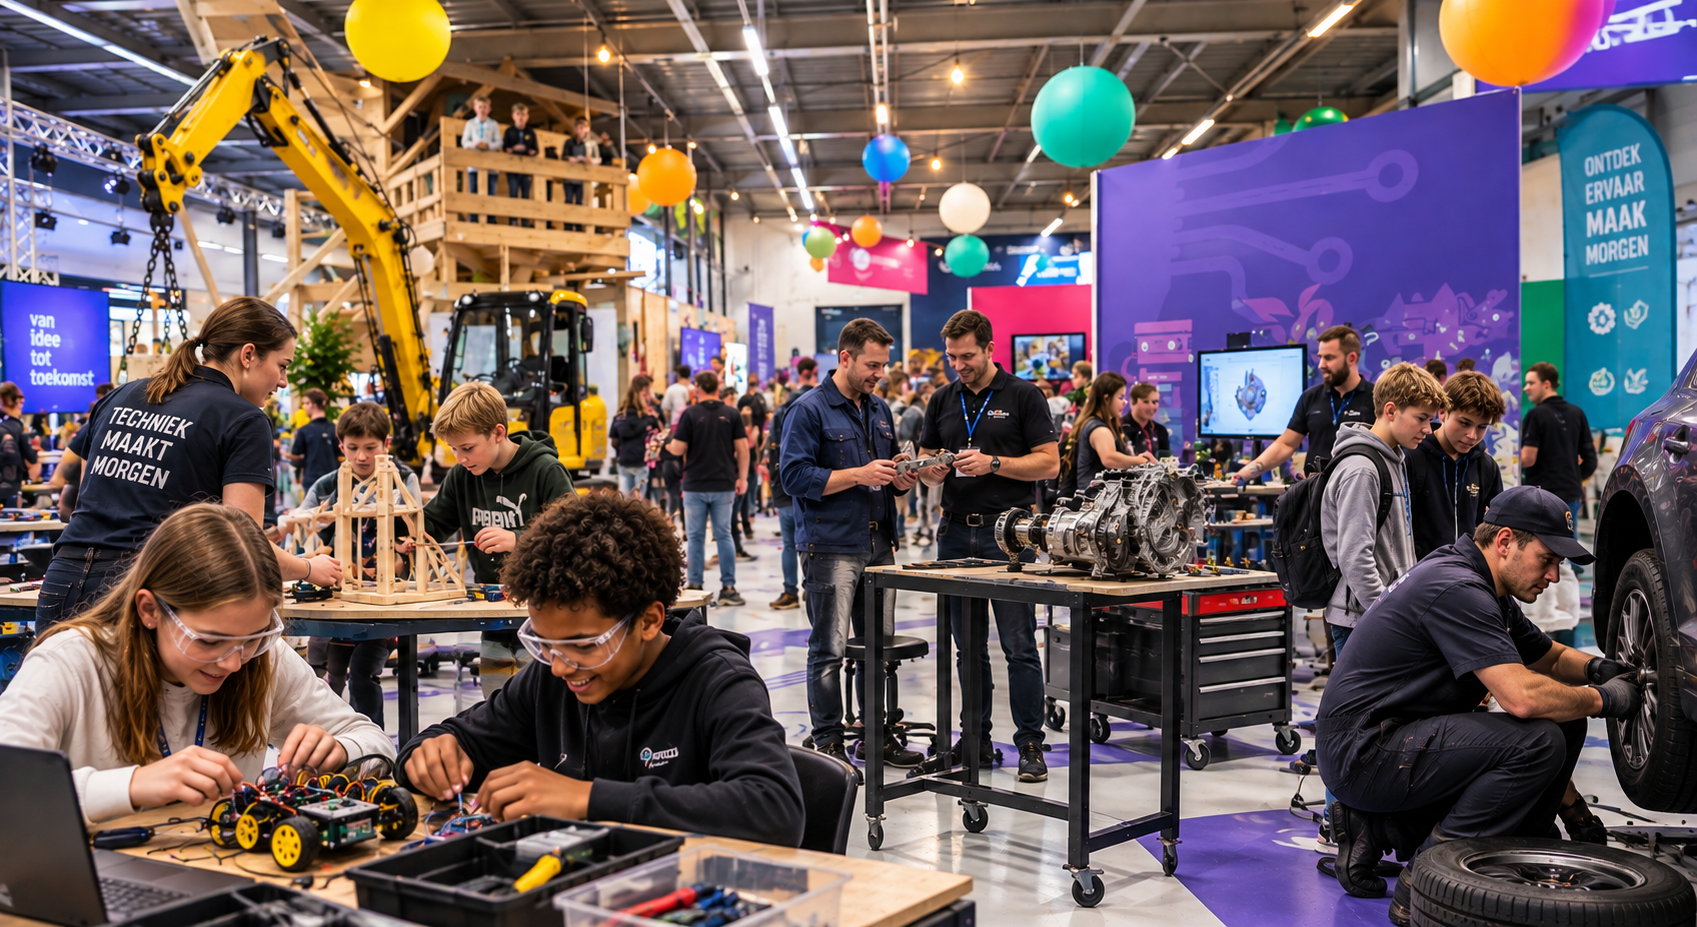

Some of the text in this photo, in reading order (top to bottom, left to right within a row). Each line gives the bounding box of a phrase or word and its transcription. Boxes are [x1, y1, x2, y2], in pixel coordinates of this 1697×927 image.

[1584, 143, 1642, 177] ONTDEK
[1585, 170, 1645, 205] ERVAAR
[1586, 200, 1647, 238] MAAK
[1585, 234, 1649, 266] MORGEN
[29, 313, 56, 329] van
[30, 328, 61, 348] idee
[30, 349, 52, 367] tot
[29, 368, 95, 387] toekomst
[108, 406, 194, 440] TECHNIEK
[100, 429, 174, 461] MAAKT
[90, 455, 171, 490] MORGEN
